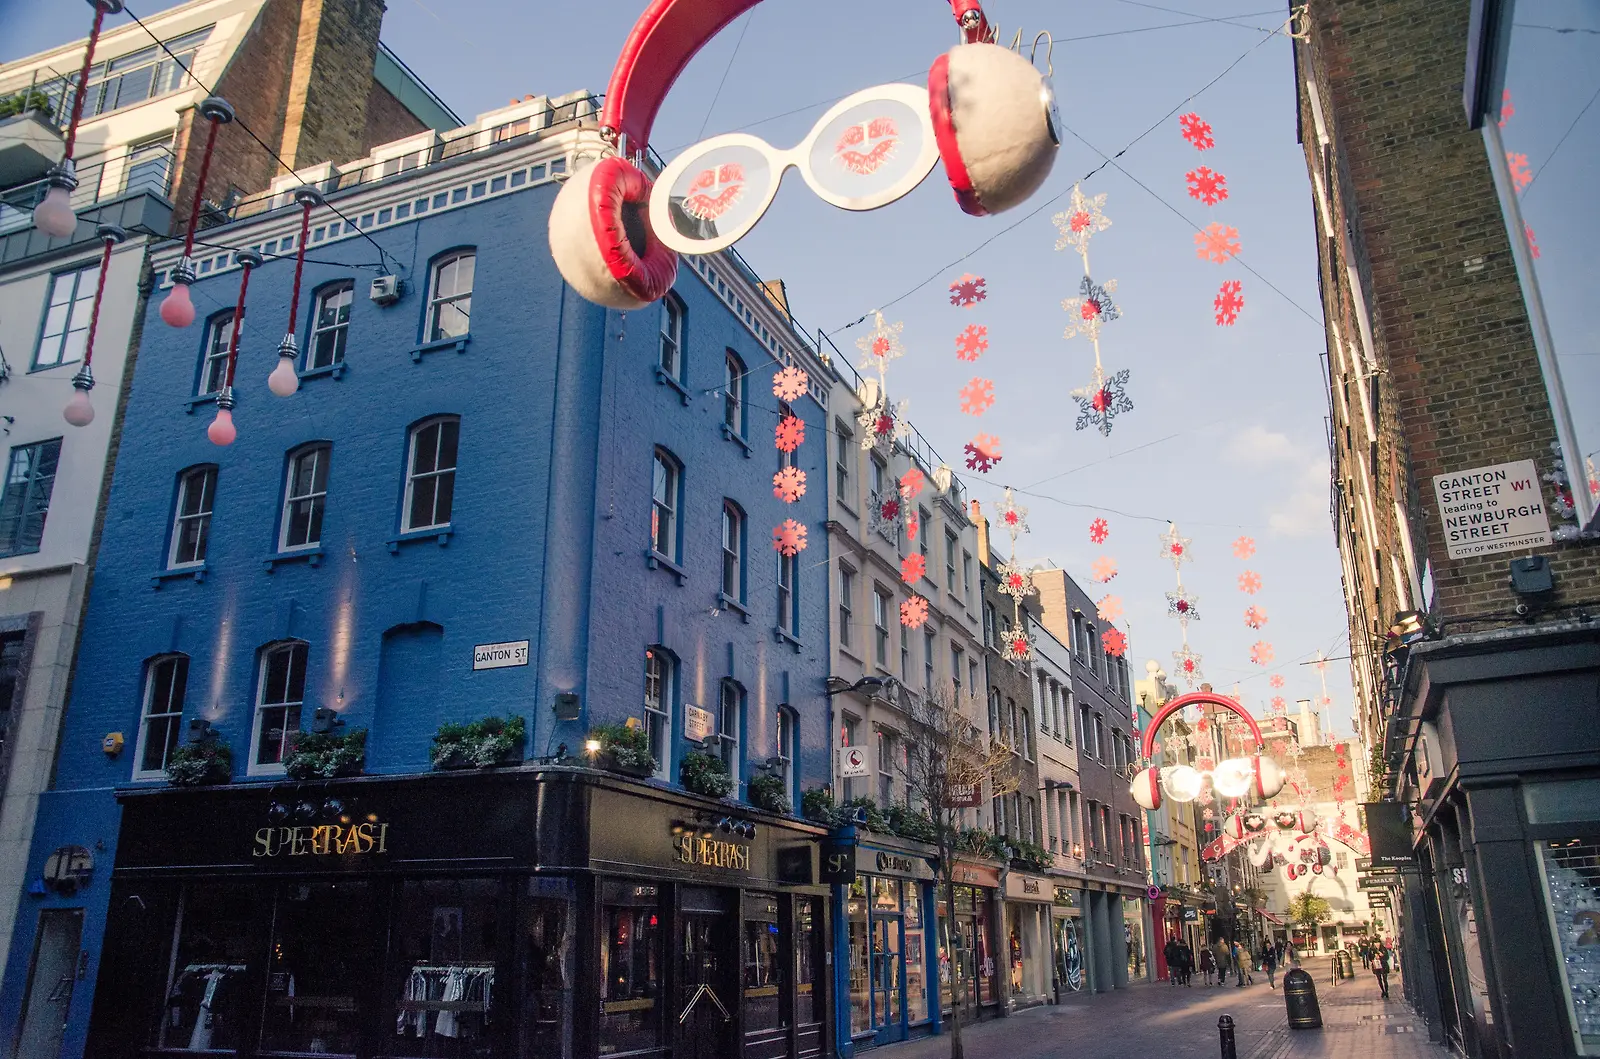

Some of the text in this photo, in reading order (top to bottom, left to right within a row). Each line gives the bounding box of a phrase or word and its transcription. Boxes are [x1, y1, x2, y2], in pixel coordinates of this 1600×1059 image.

[1439, 470, 1507, 490] GANTON
[1442, 479, 1532, 503] STREET W1
[1444, 499, 1498, 514] leading to
[1446, 504, 1542, 529] NEWBURGH
[1450, 523, 1510, 541] STREET
[1455, 537, 1545, 555] CITY OF WESTMINSTER
[475, 650, 511, 662] GANTON
[1365, 877, 1394, 885] FEMALE
